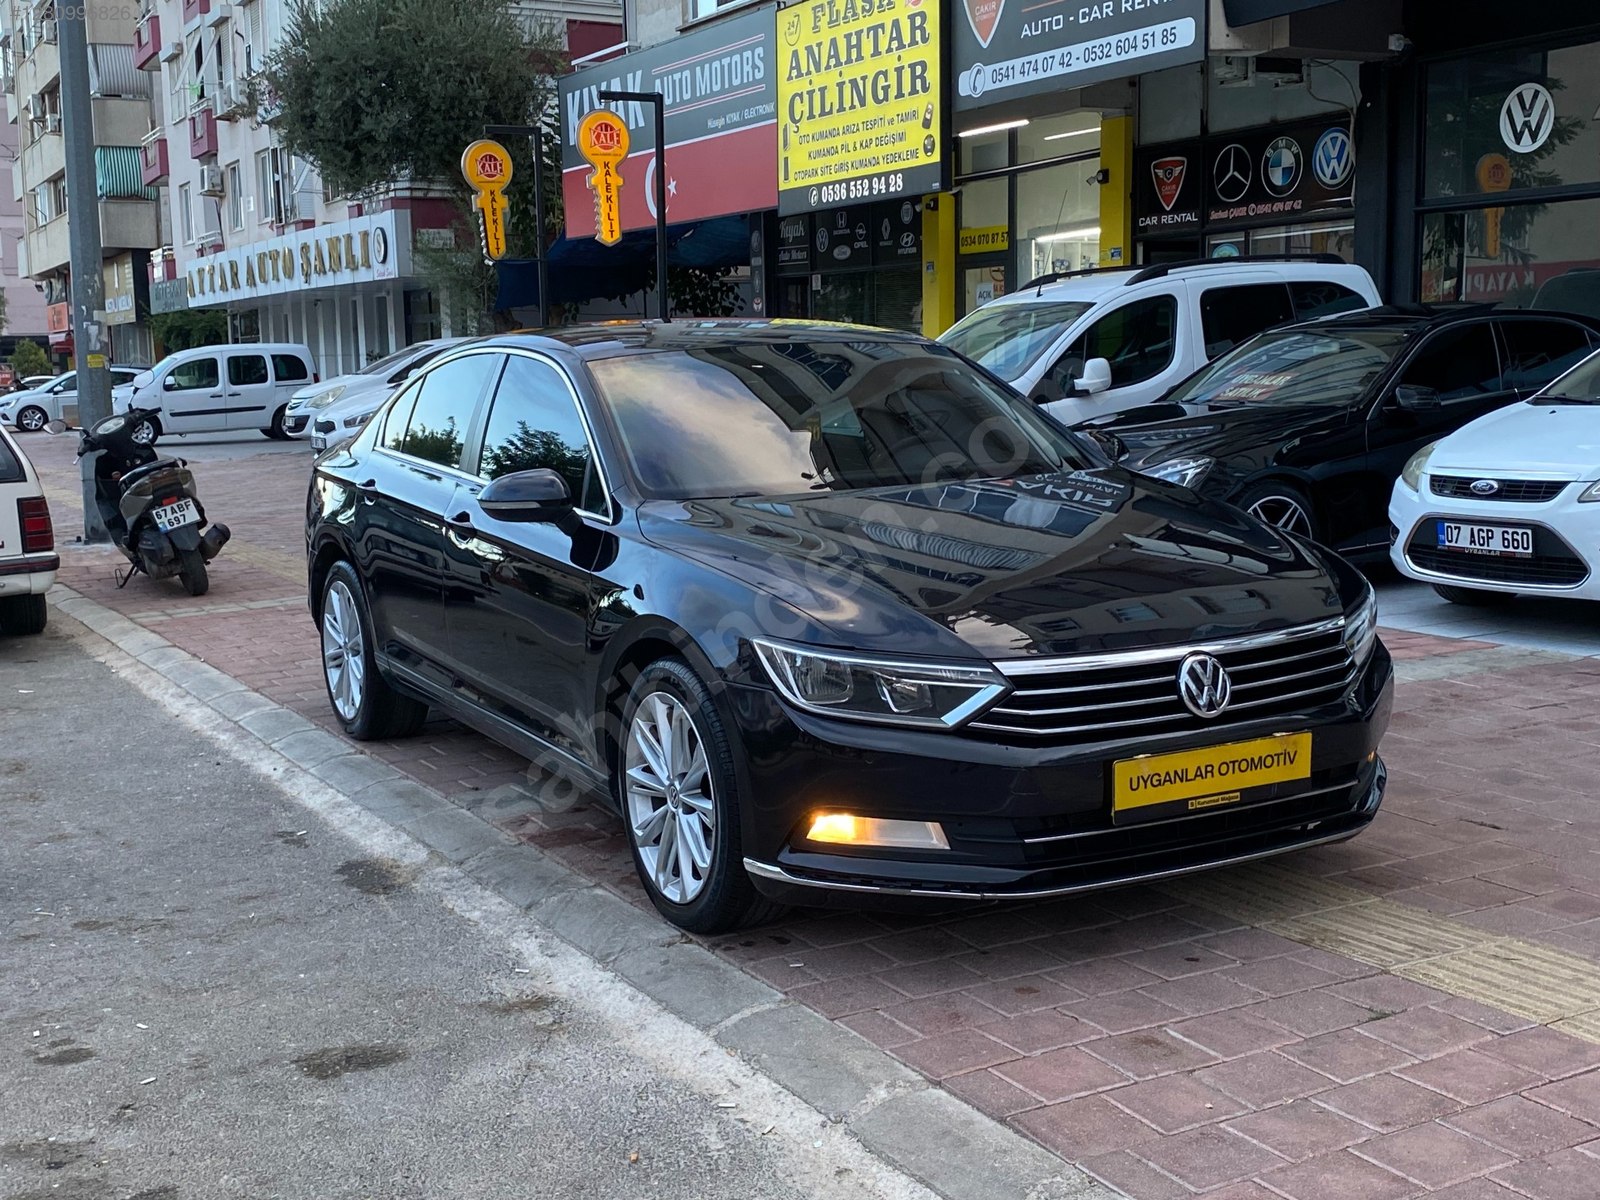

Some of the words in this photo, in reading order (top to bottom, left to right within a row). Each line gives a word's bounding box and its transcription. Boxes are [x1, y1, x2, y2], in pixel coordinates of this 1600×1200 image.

[1021, 14, 1064, 39] AUTO
[1079, 1, 1114, 24] CAR
[786, 10, 930, 81] ANAHTAR
[991, 65, 1016, 84] 0541
[1019, 59, 1039, 78] 474
[1042, 55, 1055, 73] 07
[1058, 51, 1073, 69] 42
[1083, 42, 1112, 64] 0532
[1115, 35, 1138, 56] 604
[1142, 31, 1156, 50] 51
[1161, 26, 1177, 46] 85
[655, 70, 691, 106] AUTO
[695, 46, 765, 98] MOTORS
[788, 54, 931, 134] ÇİLİNGİR
[590, 130, 621, 147] KALE
[798, 134, 810, 145] OTO
[811, 127, 840, 142] KUMANDA
[842, 123, 860, 136] ARIZA
[862, 117, 886, 132] TESPİTİ
[887, 118, 895, 126] ve
[808, 146, 839, 160] KUMANDA
[840, 141, 851, 153] PİL
[853, 141, 858, 152] &
[859, 137, 874, 150] KAP
[477, 159, 504, 176] KALE
[794, 167, 819, 181] OTOPARK
[820, 163, 833, 176] SİTE
[834, 160, 850, 174] GİRİŞ
[850, 156, 880, 171] KUMANDA
[881, 148, 919, 165] YEDEKLEME
[821, 183, 847, 203] 0536
[850, 178, 869, 198] 552
[872, 175, 886, 195] 94
[889, 172, 903, 193] 28
[1138, 216, 1158, 227] CAR
[1161, 211, 1198, 224] RENTAL
[961, 235, 976, 247] 0534
[977, 233, 990, 246] 070
[991, 232, 1000, 243] 87
[1000, 231, 1009, 243] 57
[246, 246, 295, 288] AUTO
[300, 230, 371, 285] ŞANLI
[977, 290, 992, 301] AÇIK
[155, 508, 168, 520] 67
[170, 499, 193, 516] ABF
[167, 513, 187, 528] 697
[1446, 525, 1461, 544] 07
[1469, 527, 1494, 548] AGP
[1502, 529, 1530, 551] 660
[1129, 764, 1215, 792] UYGANLAR
[1218, 749, 1298, 777] OTOMOTİV
